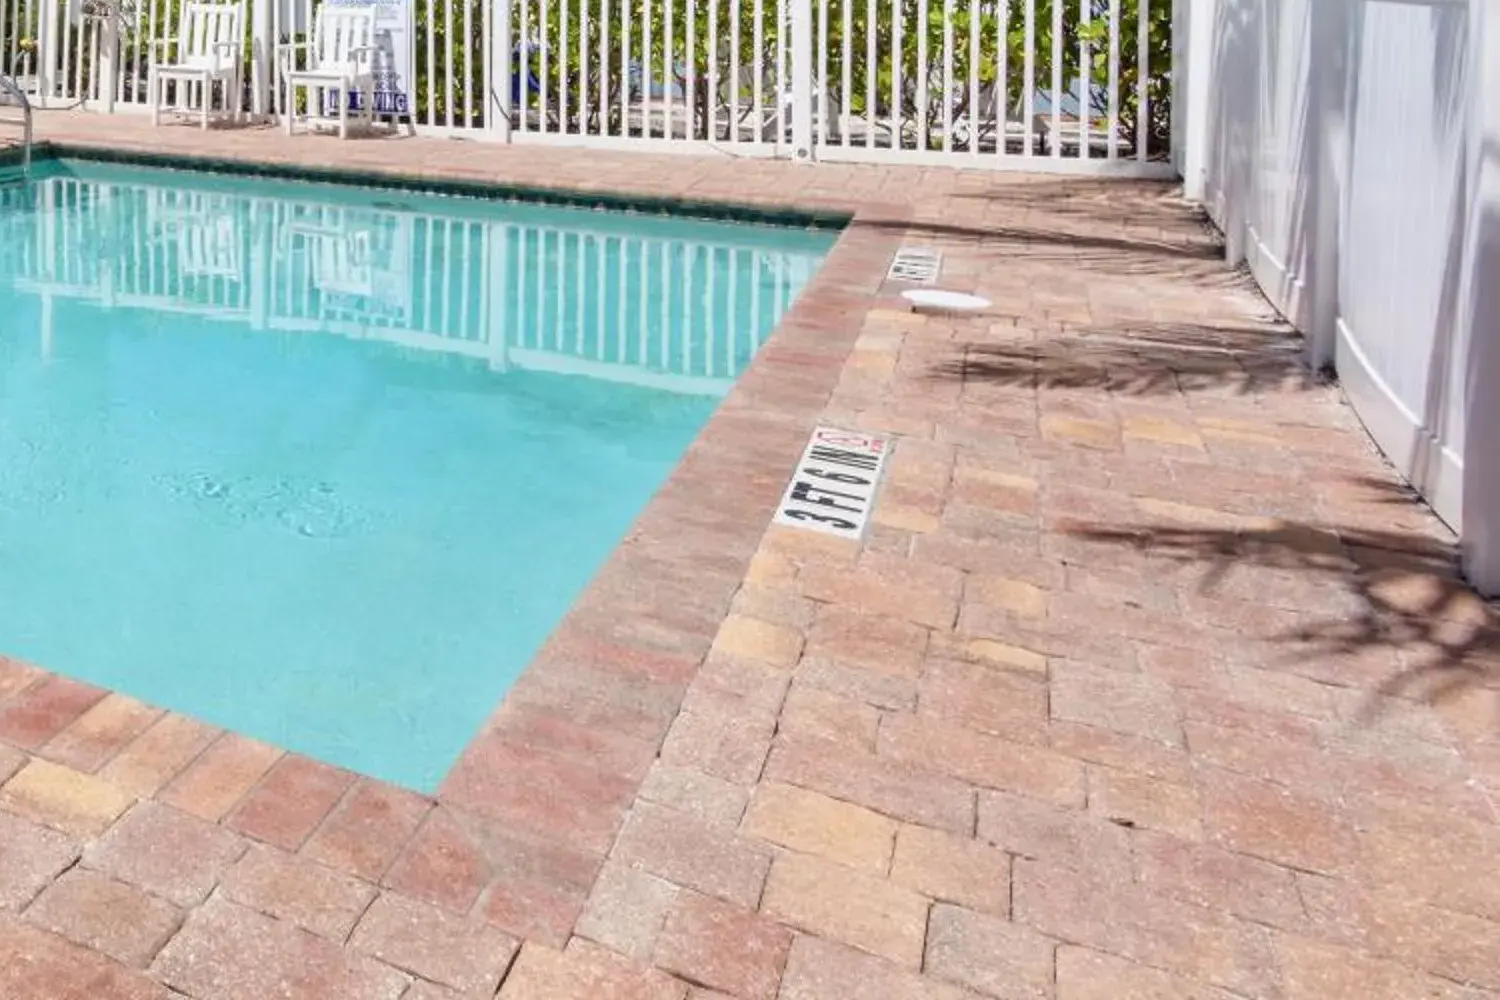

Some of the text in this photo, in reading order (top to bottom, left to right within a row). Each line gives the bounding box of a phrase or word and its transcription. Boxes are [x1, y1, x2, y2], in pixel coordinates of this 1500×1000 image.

[803, 468, 872, 485] 6
[790, 481, 867, 514] FT
[784, 508, 858, 530] 3
